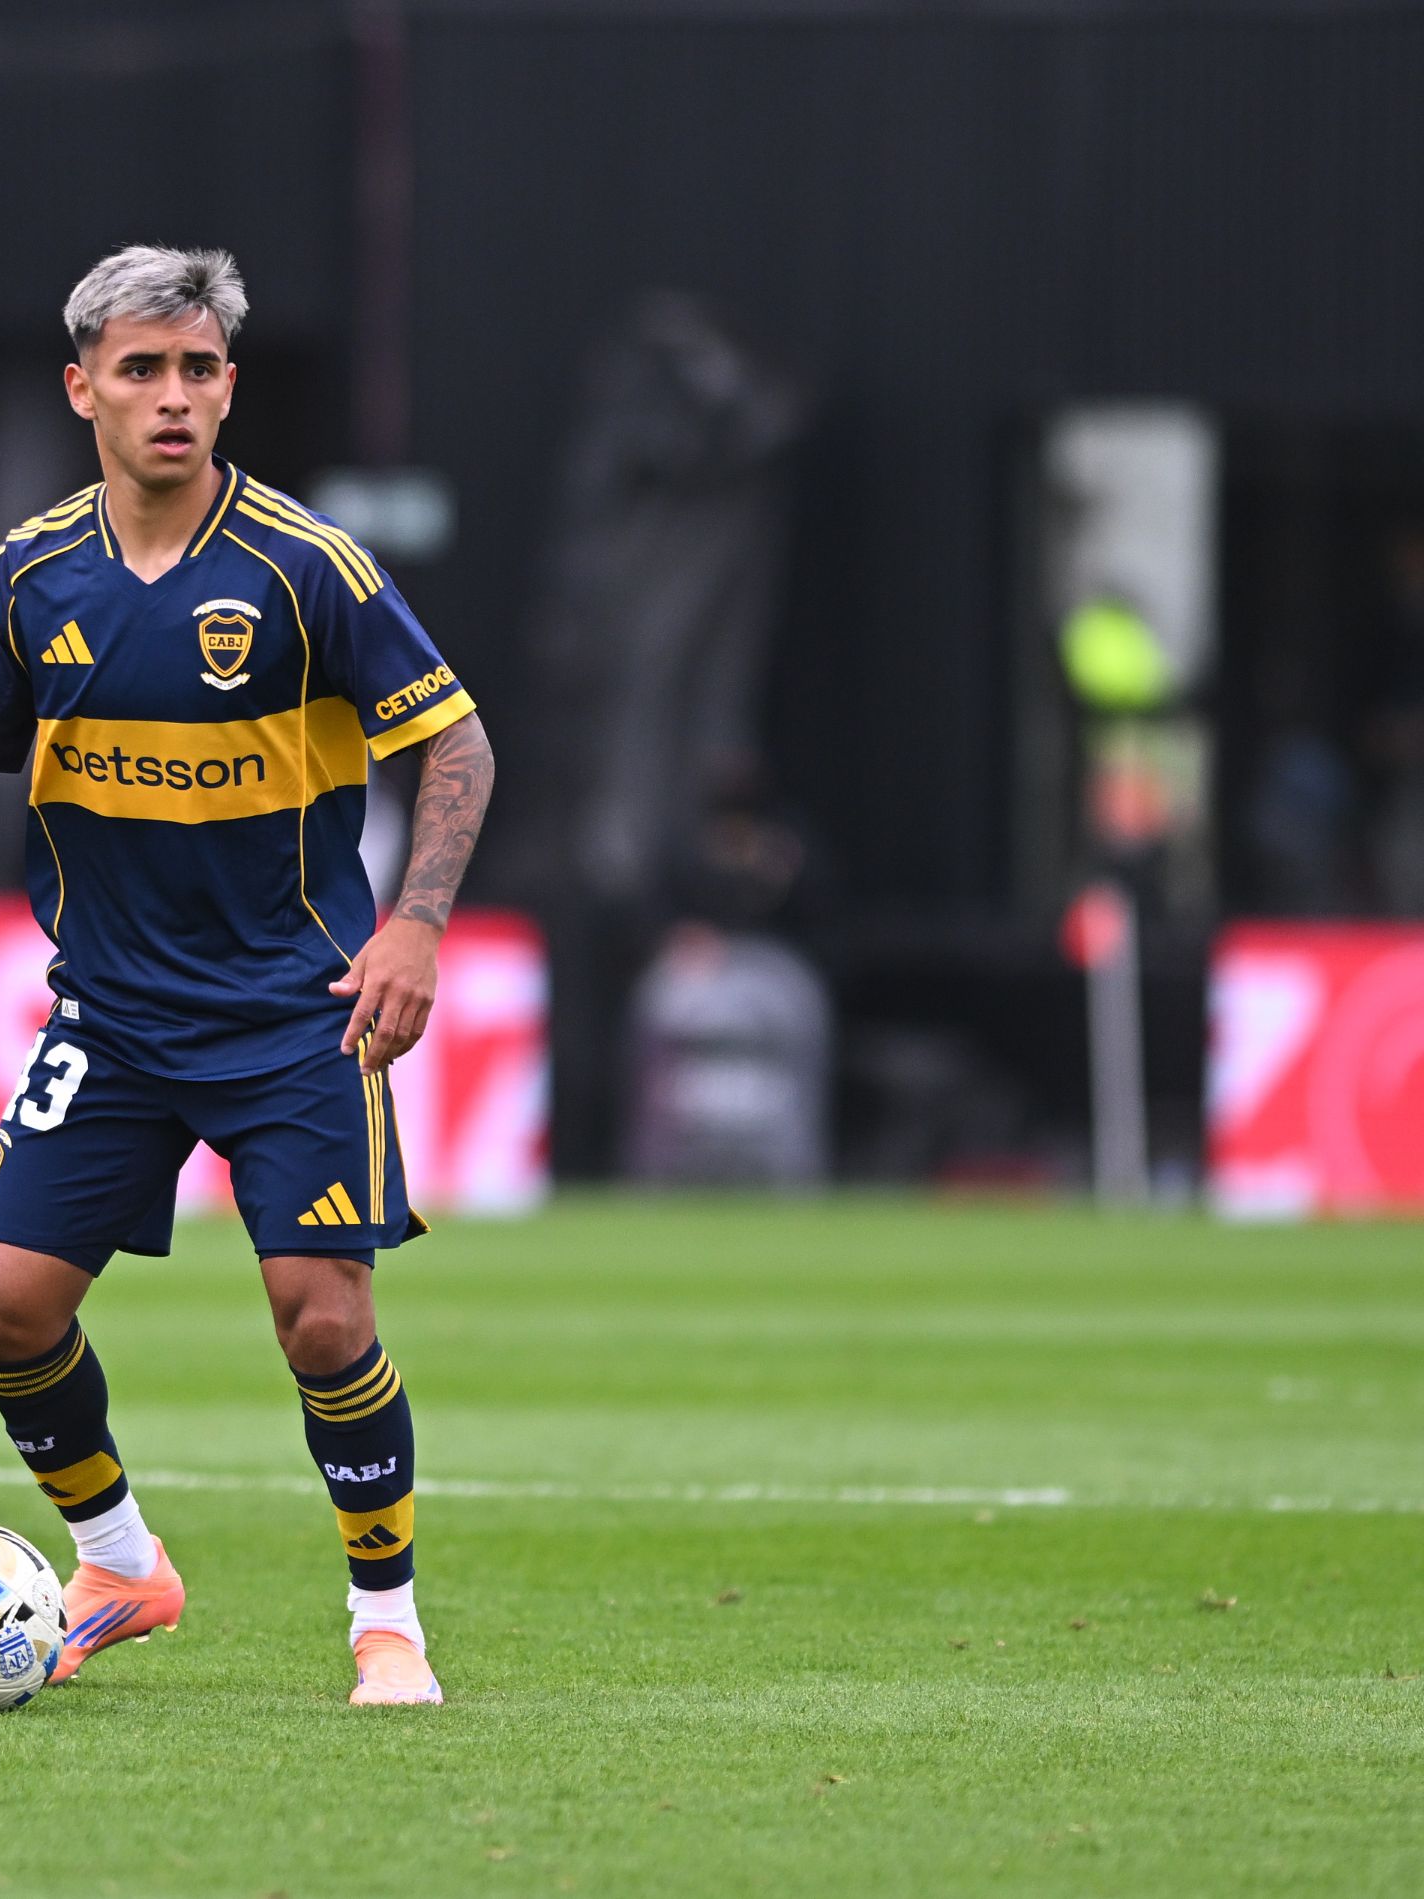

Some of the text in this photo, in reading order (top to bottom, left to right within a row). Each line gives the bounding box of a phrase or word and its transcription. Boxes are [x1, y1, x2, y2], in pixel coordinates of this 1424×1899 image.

[208, 636, 245, 648] CABJ
[51, 742, 266, 791] betsson
[324, 1456, 397, 1482] CABJ
